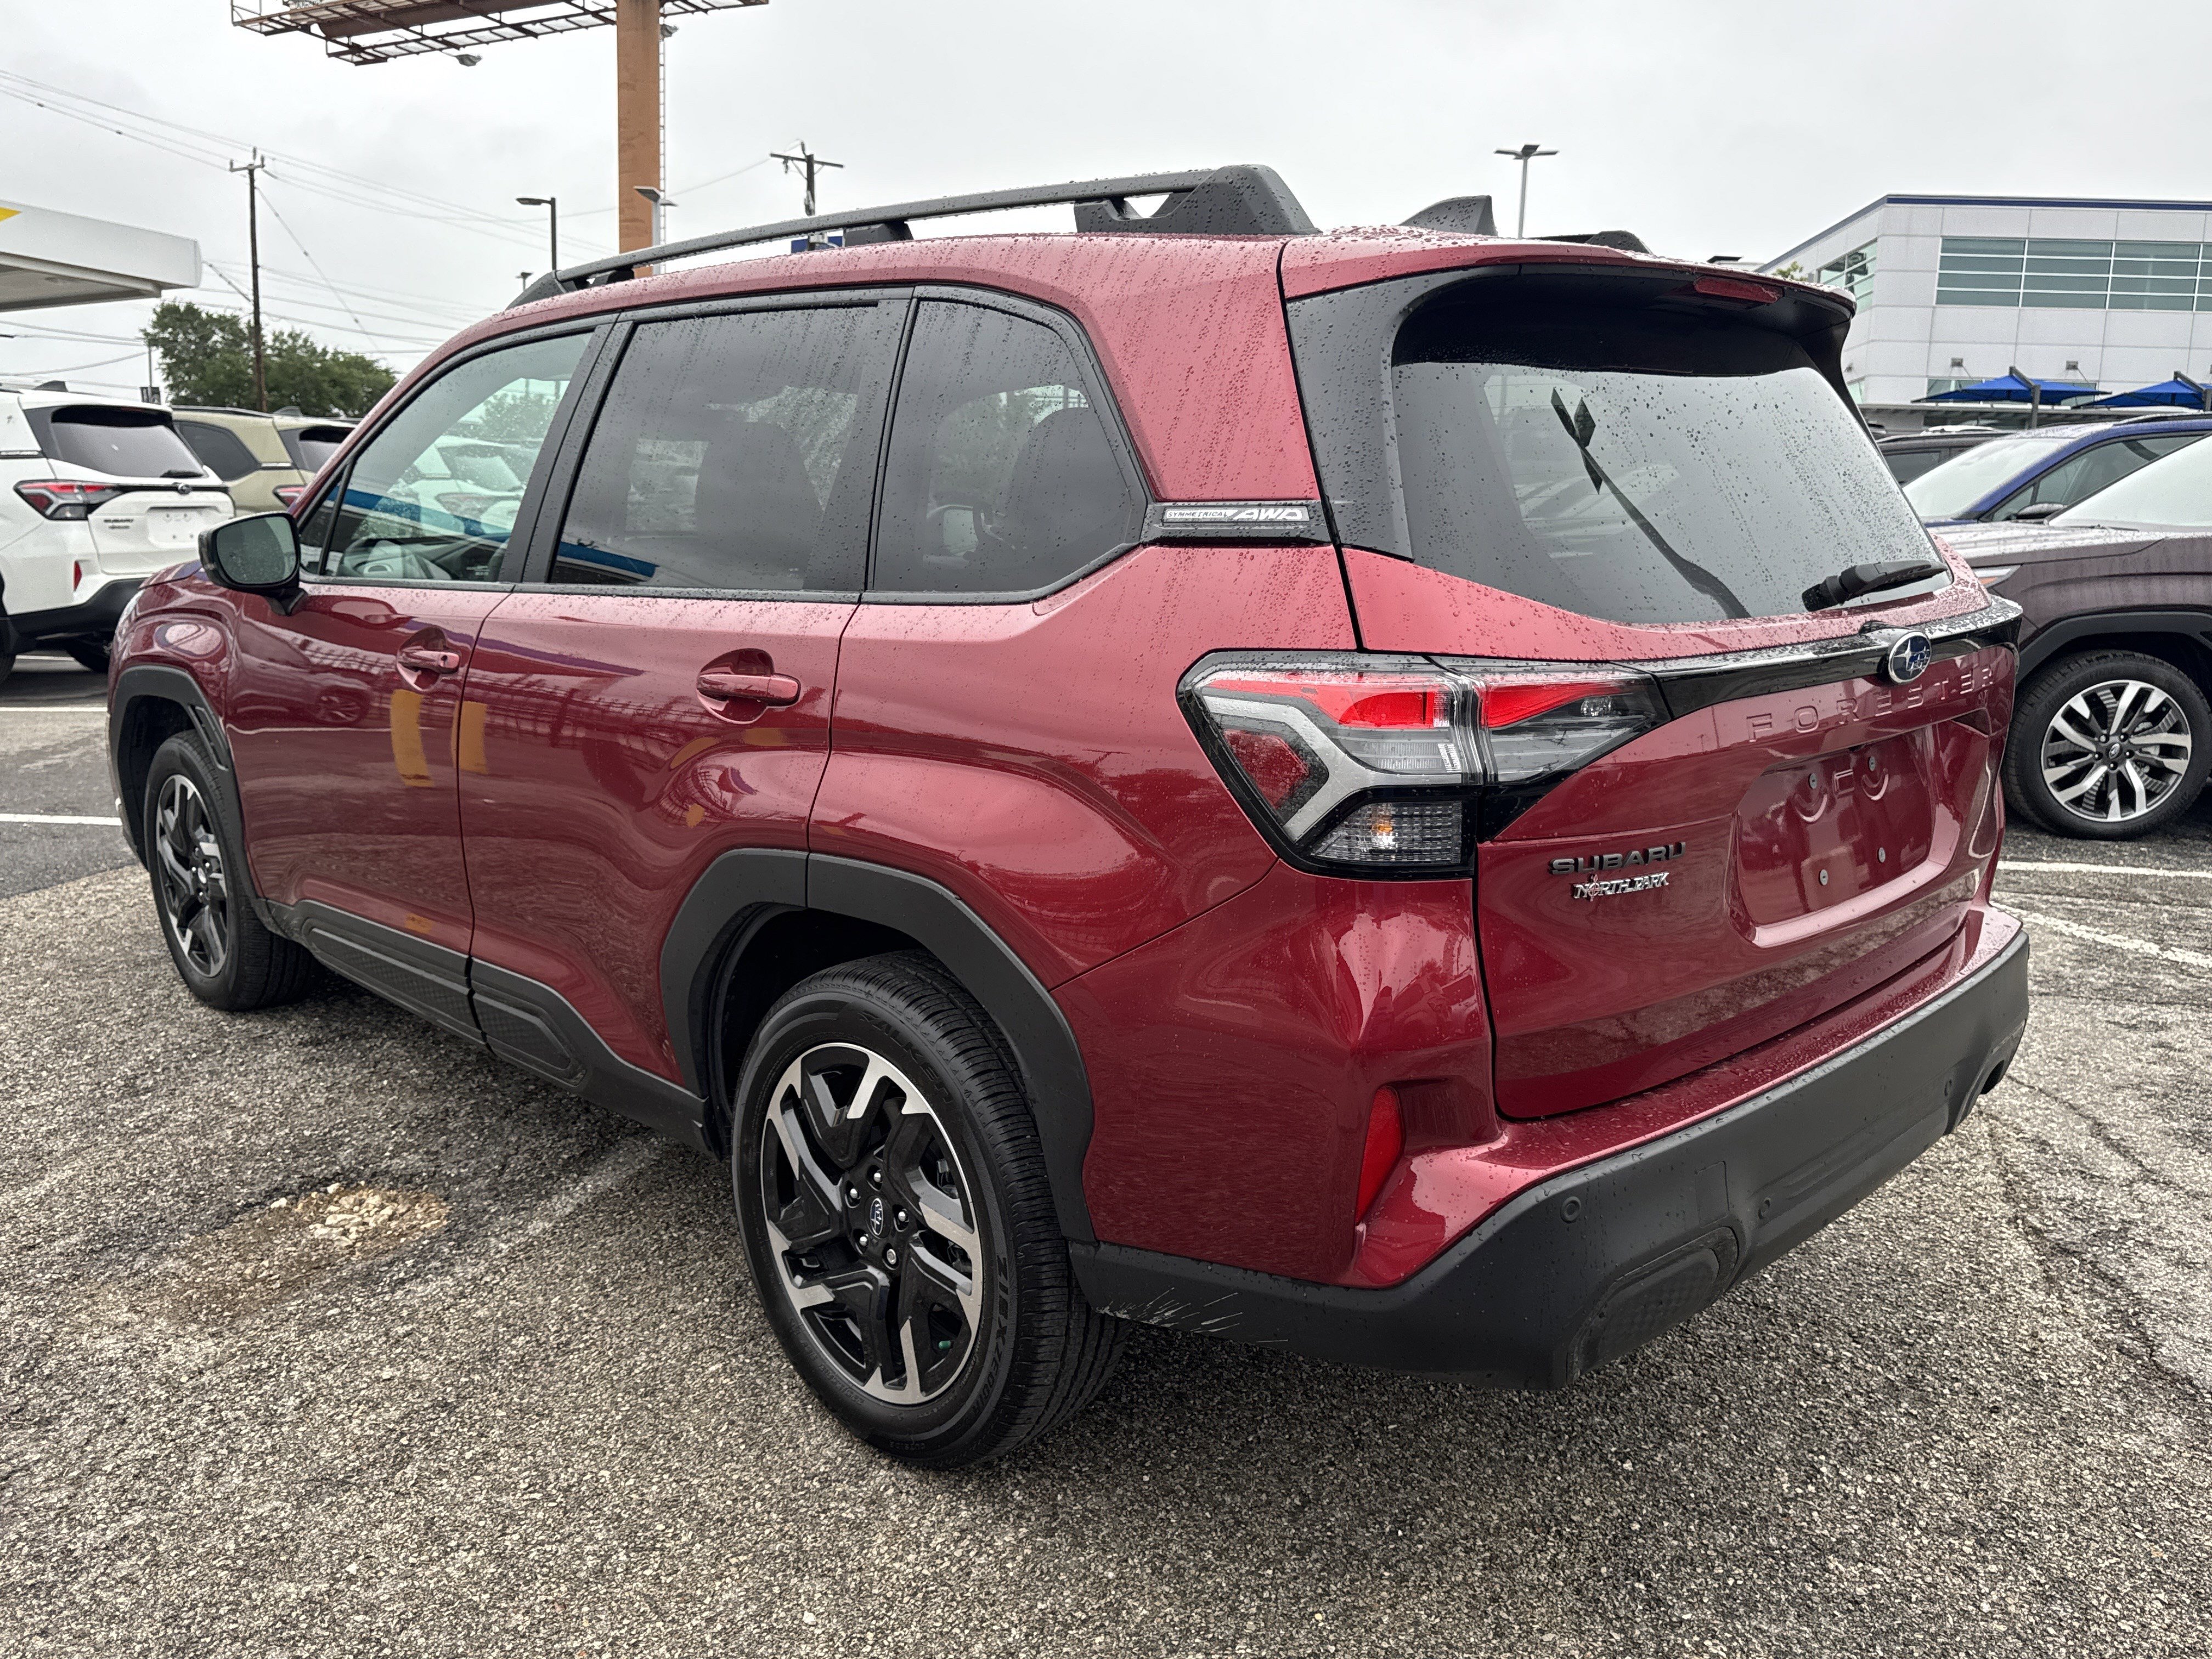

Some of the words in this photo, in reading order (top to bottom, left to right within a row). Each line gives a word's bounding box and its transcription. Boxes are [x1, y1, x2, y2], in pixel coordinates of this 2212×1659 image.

[1167, 510, 1229, 518] SYMMETRICAL
[1233, 509, 1304, 520] AWD
[1746, 666, 1994, 743] FORESTER
[1549, 842, 1686, 875] SUBARU
